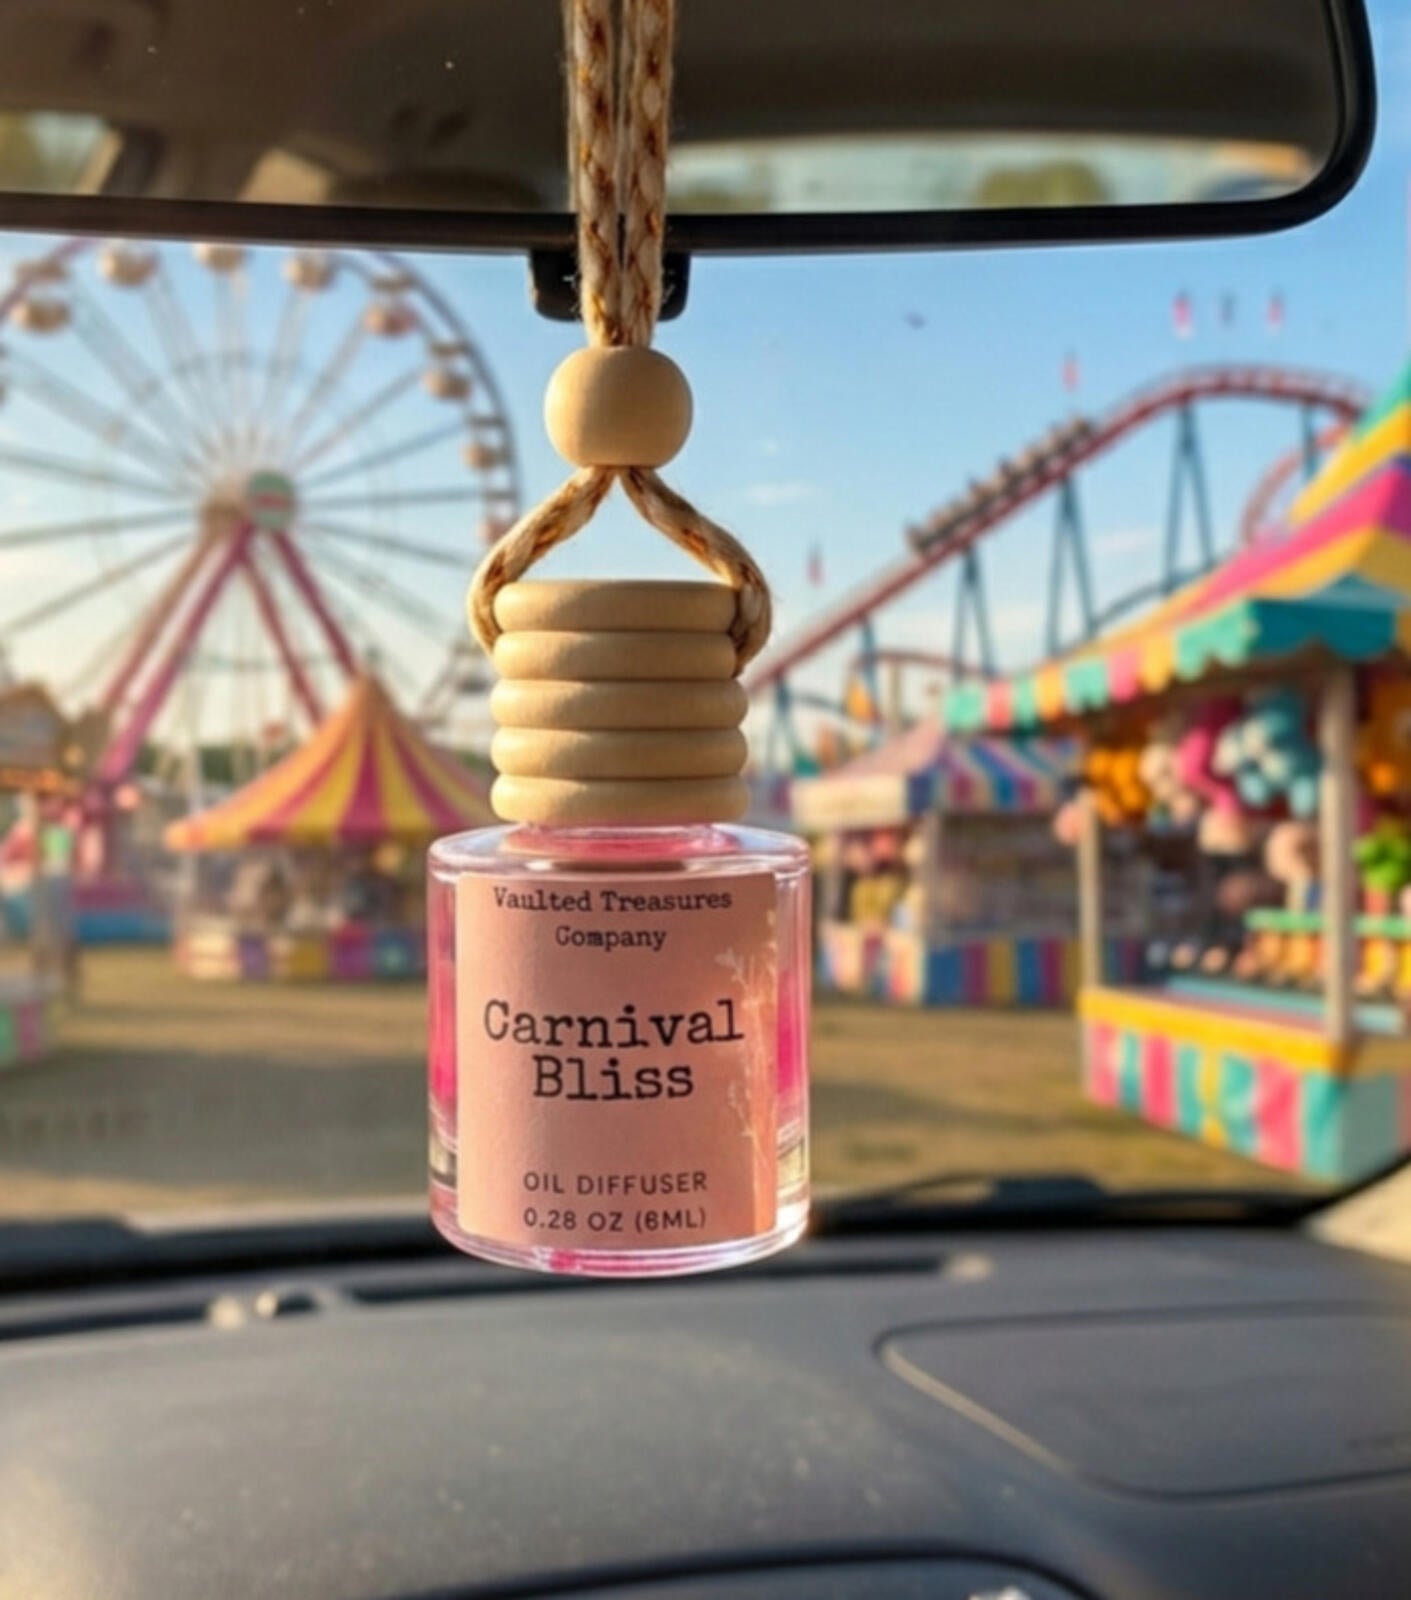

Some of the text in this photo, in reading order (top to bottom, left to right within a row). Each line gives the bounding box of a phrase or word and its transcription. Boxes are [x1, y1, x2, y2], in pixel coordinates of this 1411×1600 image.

[493, 886, 733, 912] Vaulted Treasures
[555, 926, 667, 951] Company
[483, 999, 744, 1048] Carnival
[532, 1054, 694, 1101] Bliss
[523, 1171, 708, 1195] OIL DIFFUSER
[523, 1207, 576, 1228] 0.28
[588, 1211, 623, 1232] OZ
